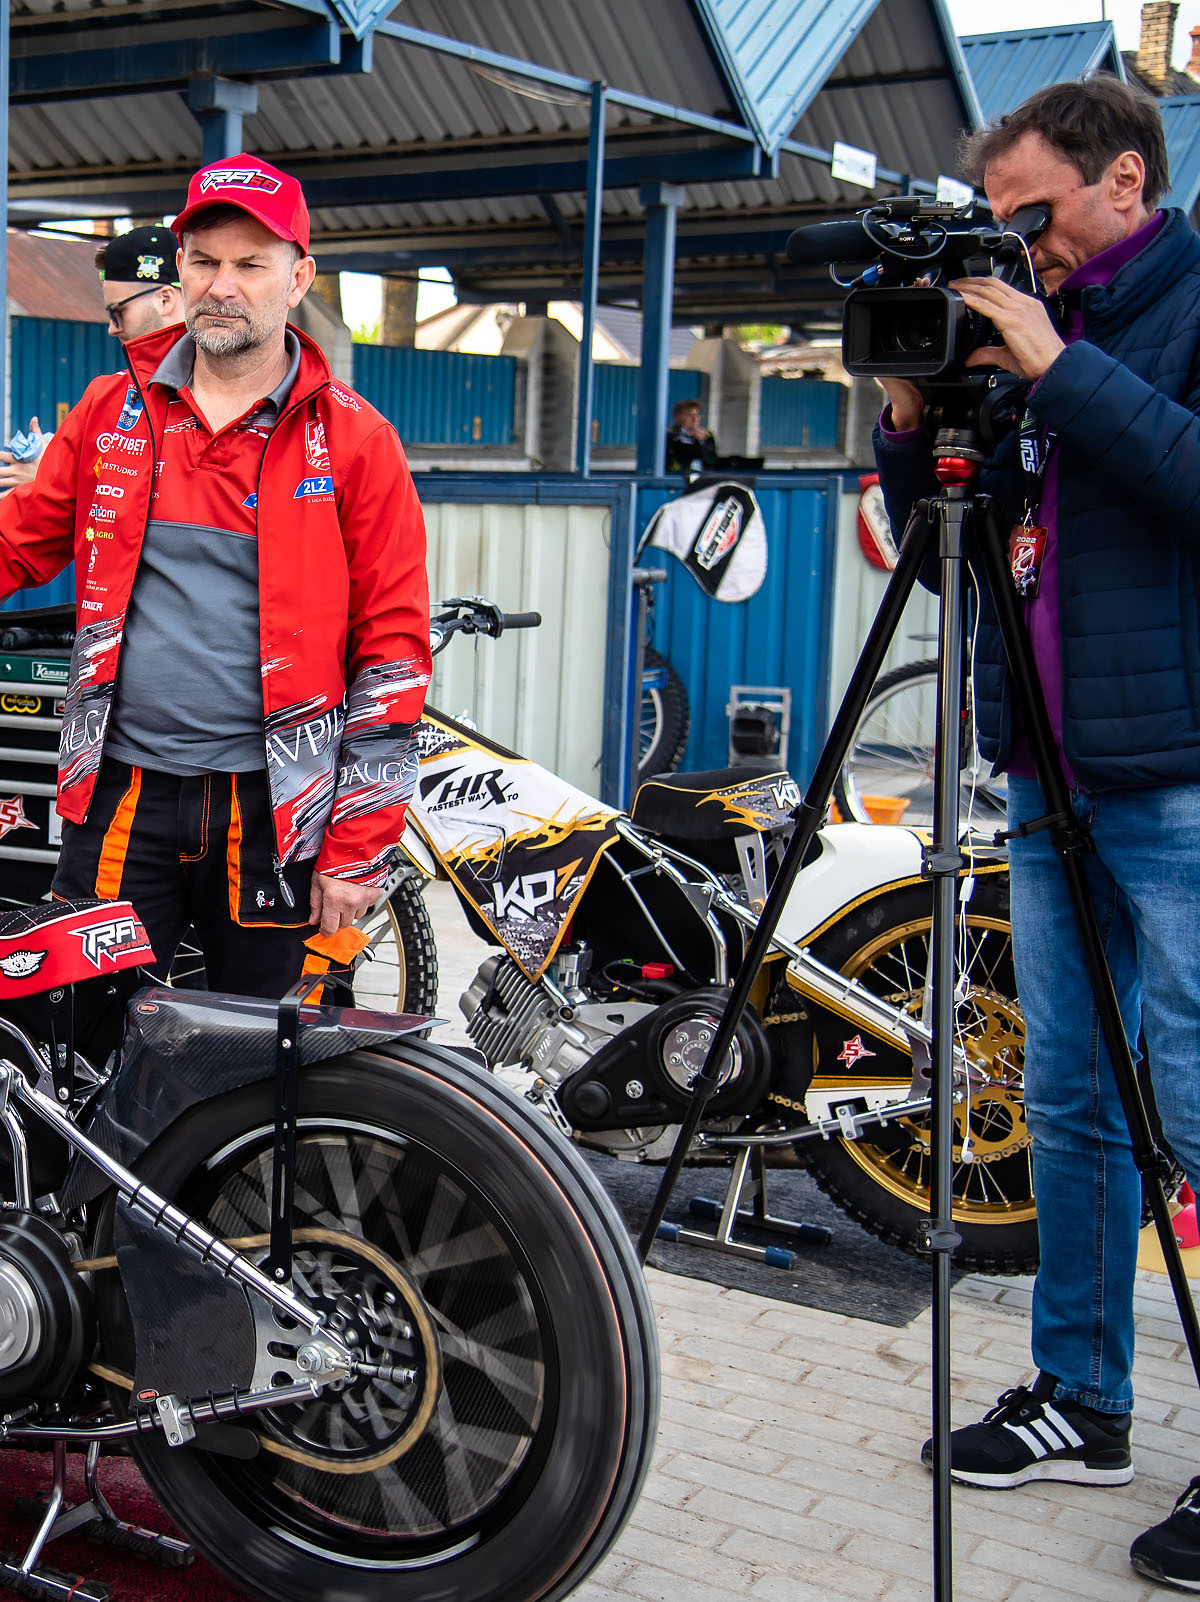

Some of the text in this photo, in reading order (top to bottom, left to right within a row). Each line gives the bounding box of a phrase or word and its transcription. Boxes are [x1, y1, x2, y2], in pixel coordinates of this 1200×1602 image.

[96, 432, 147, 454] OPTIBET
[109, 464, 138, 477] STUDIOS
[303, 478, 327, 493] 2LŻ
[36, 664, 69, 678] Kamasa
[6, 697, 36, 706] REGINA
[427, 791, 519, 814] FASTEST WAY TO
